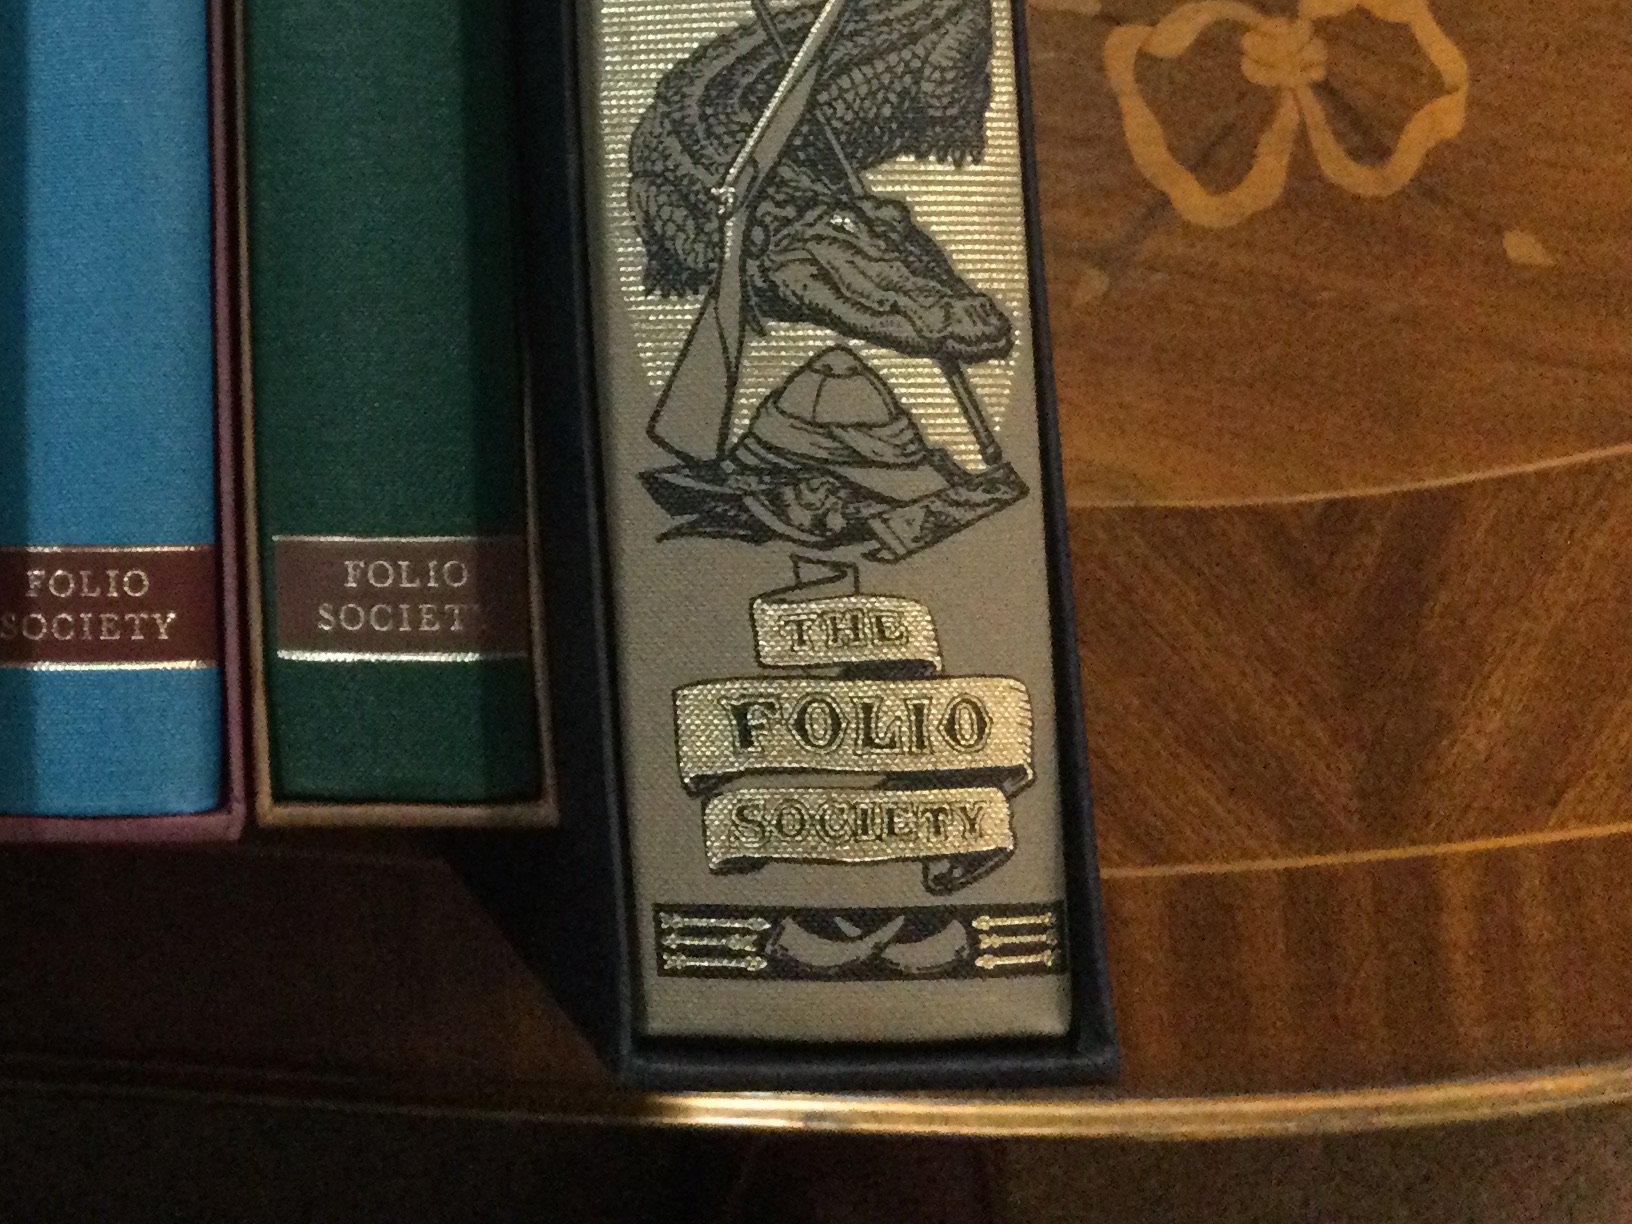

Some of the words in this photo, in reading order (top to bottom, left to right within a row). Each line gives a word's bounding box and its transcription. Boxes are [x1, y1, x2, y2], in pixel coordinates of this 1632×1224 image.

[25, 569, 151, 598] FOLIO
[343, 560, 469, 588] FOLIO
[0, 611, 177, 642] SOCIETY
[781, 608, 909, 652] THE
[720, 692, 994, 756] FOLIO
[731, 798, 989, 850] SOCIETY
